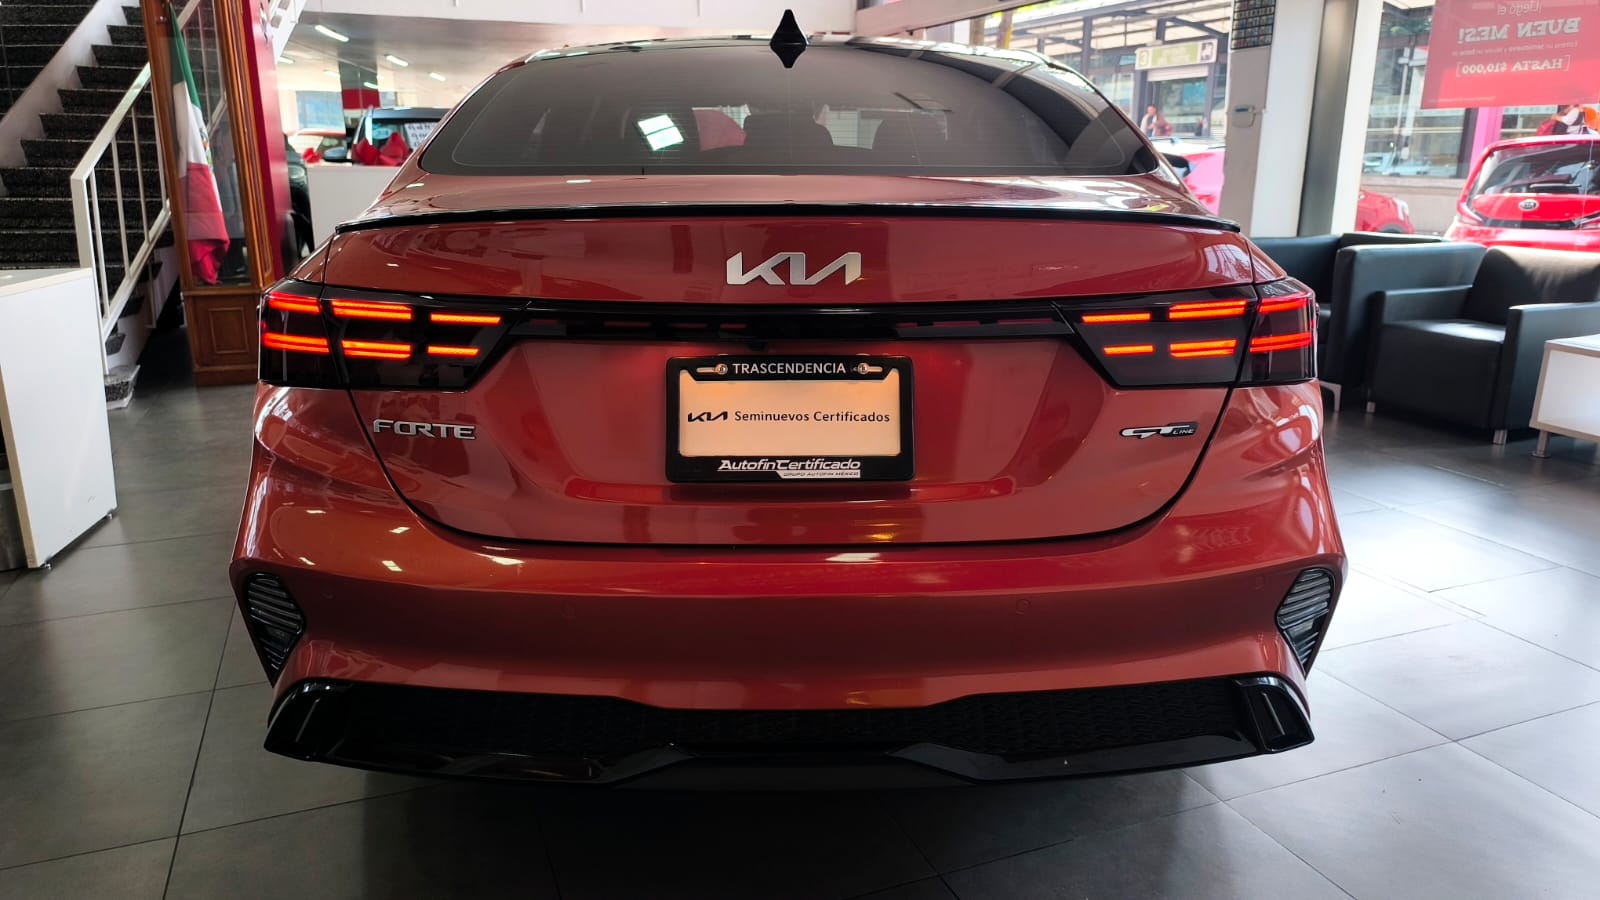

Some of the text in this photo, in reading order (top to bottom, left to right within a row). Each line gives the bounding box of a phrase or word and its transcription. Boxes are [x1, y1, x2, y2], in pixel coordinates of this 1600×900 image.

[726, 252, 862, 286] KIA
[732, 362, 847, 375] TRASCENDENCIA
[687, 411, 890, 423] KIA Seminuevos Certificados
[373, 418, 476, 440] FORTE
[1121, 425, 1190, 439] GT
